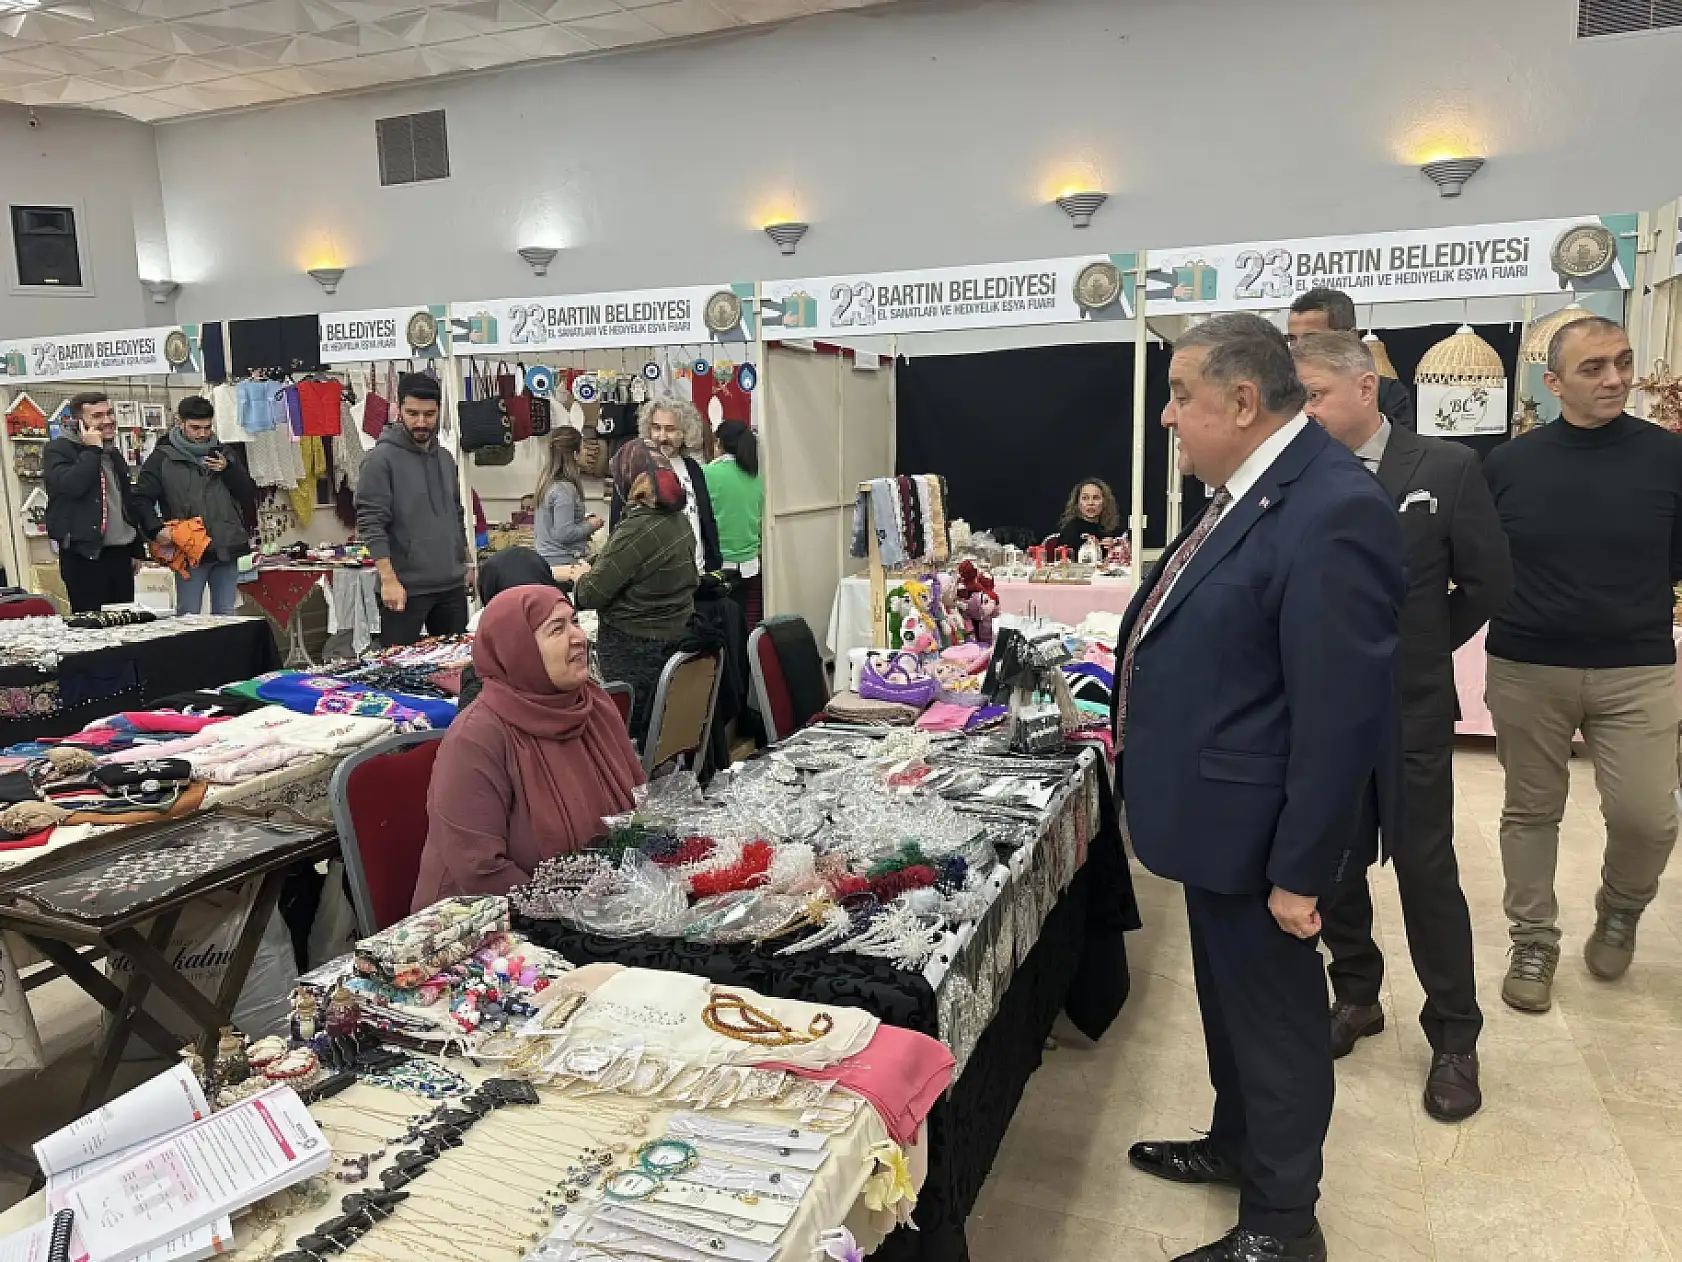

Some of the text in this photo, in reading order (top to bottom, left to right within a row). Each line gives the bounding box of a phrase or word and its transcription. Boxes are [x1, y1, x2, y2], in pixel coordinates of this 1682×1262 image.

[1234, 248, 1293, 300] 23
[1297, 247, 1382, 277] BARTIN
[1295, 279, 1309, 292] EL
[1311, 273, 1374, 290] SANATLARI
[1378, 273, 1392, 286] VE
[1491, 264, 1529, 279] FUARI
[829, 280, 876, 328] 23
[877, 280, 943, 308] BARTIN
[940, 304, 952, 317] VE
[508, 303, 548, 345] 23
[547, 304, 601, 327] BARTIN
[57, 342, 95, 361] BARTIN
